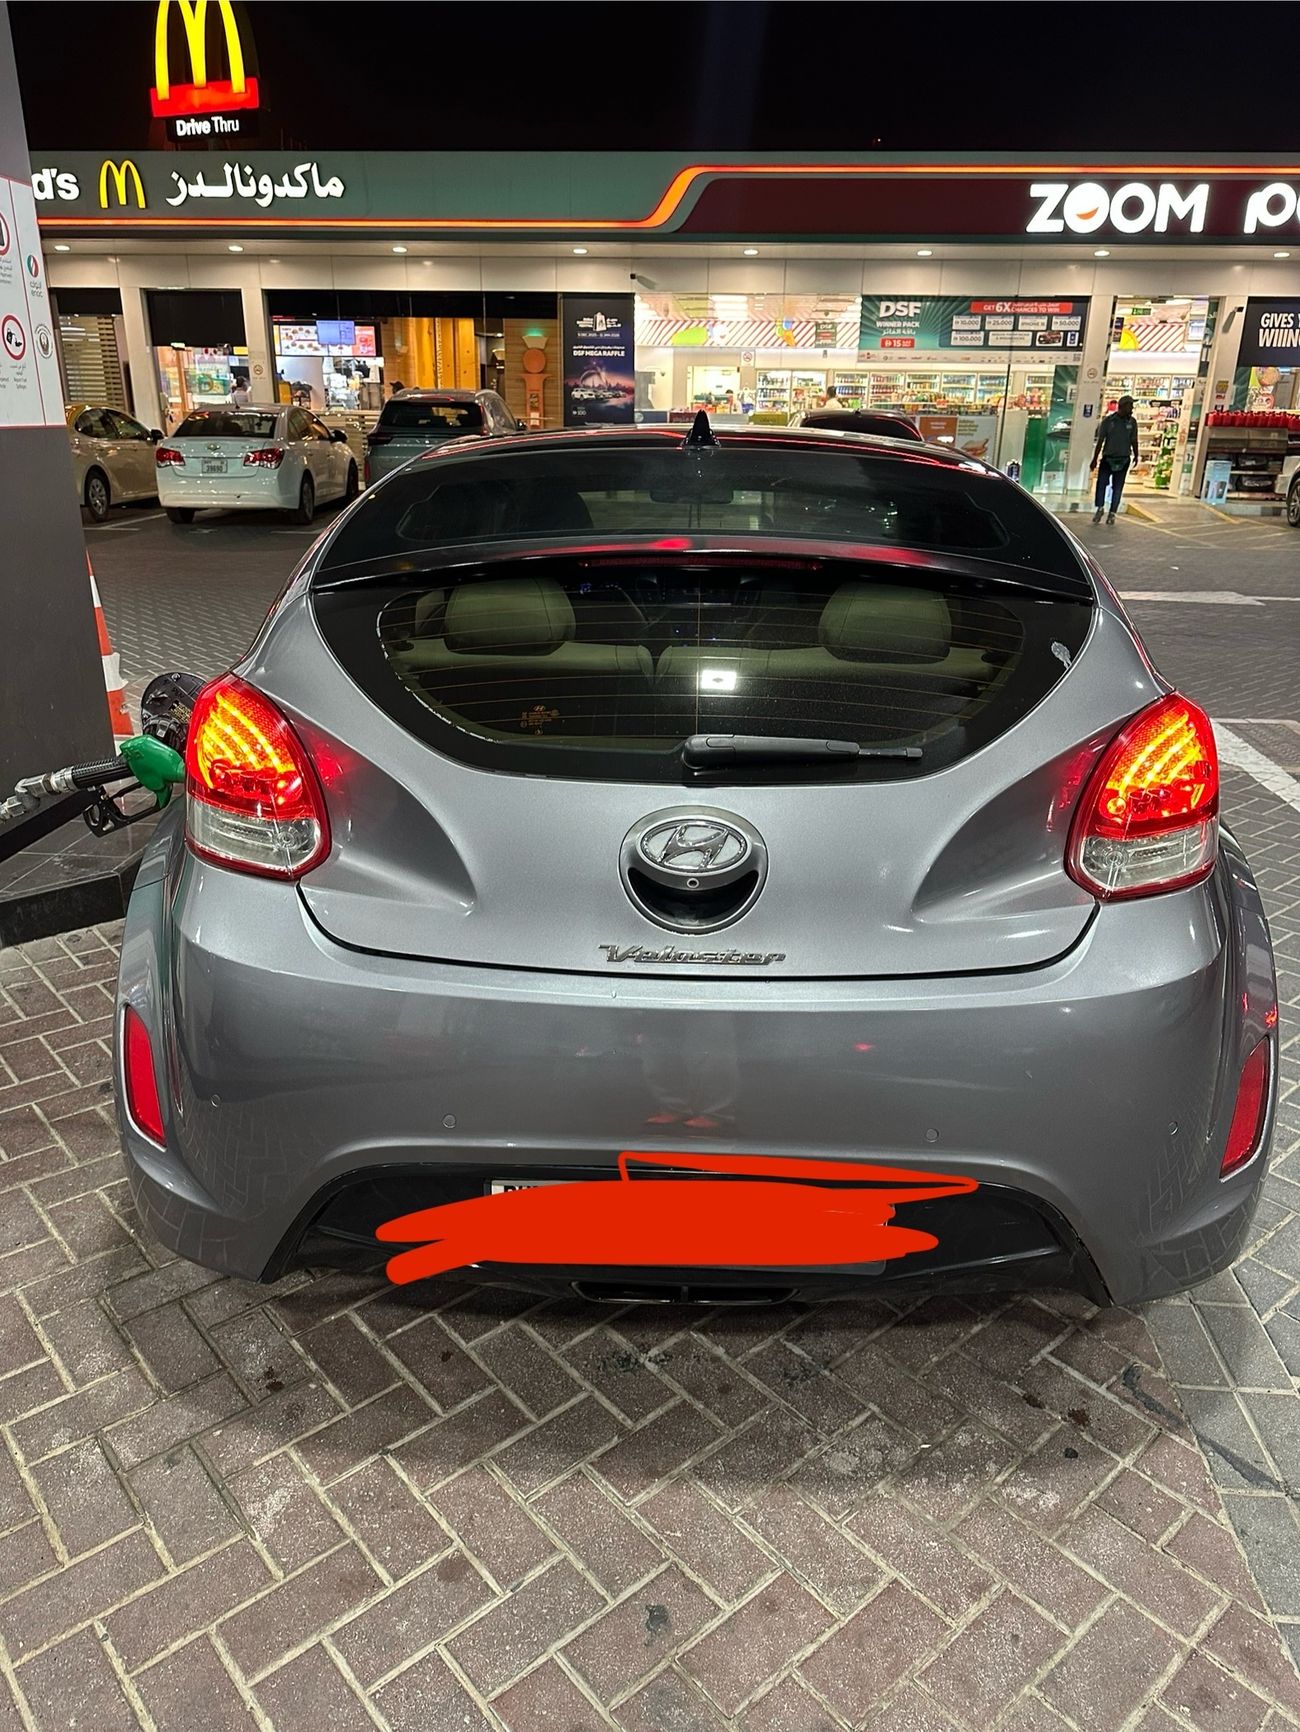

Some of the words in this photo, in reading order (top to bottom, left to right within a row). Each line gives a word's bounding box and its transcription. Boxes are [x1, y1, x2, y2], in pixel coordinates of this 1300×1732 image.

[176, 119, 211, 137] Drive
[213, 116, 240, 133] Thru
[165, 162, 345, 208] ماكدونالدز
[1026, 182, 1210, 234] ZOOM
[880, 301, 921, 318] DSF
[995, 302, 1012, 313] 6X
[902, 321, 920, 329] PACK
[1260, 312, 1295, 328] GIVES
[893, 339, 902, 347] 15
[1258, 328, 1300, 348] WIIIN
[598, 944, 787, 965] Veloster
